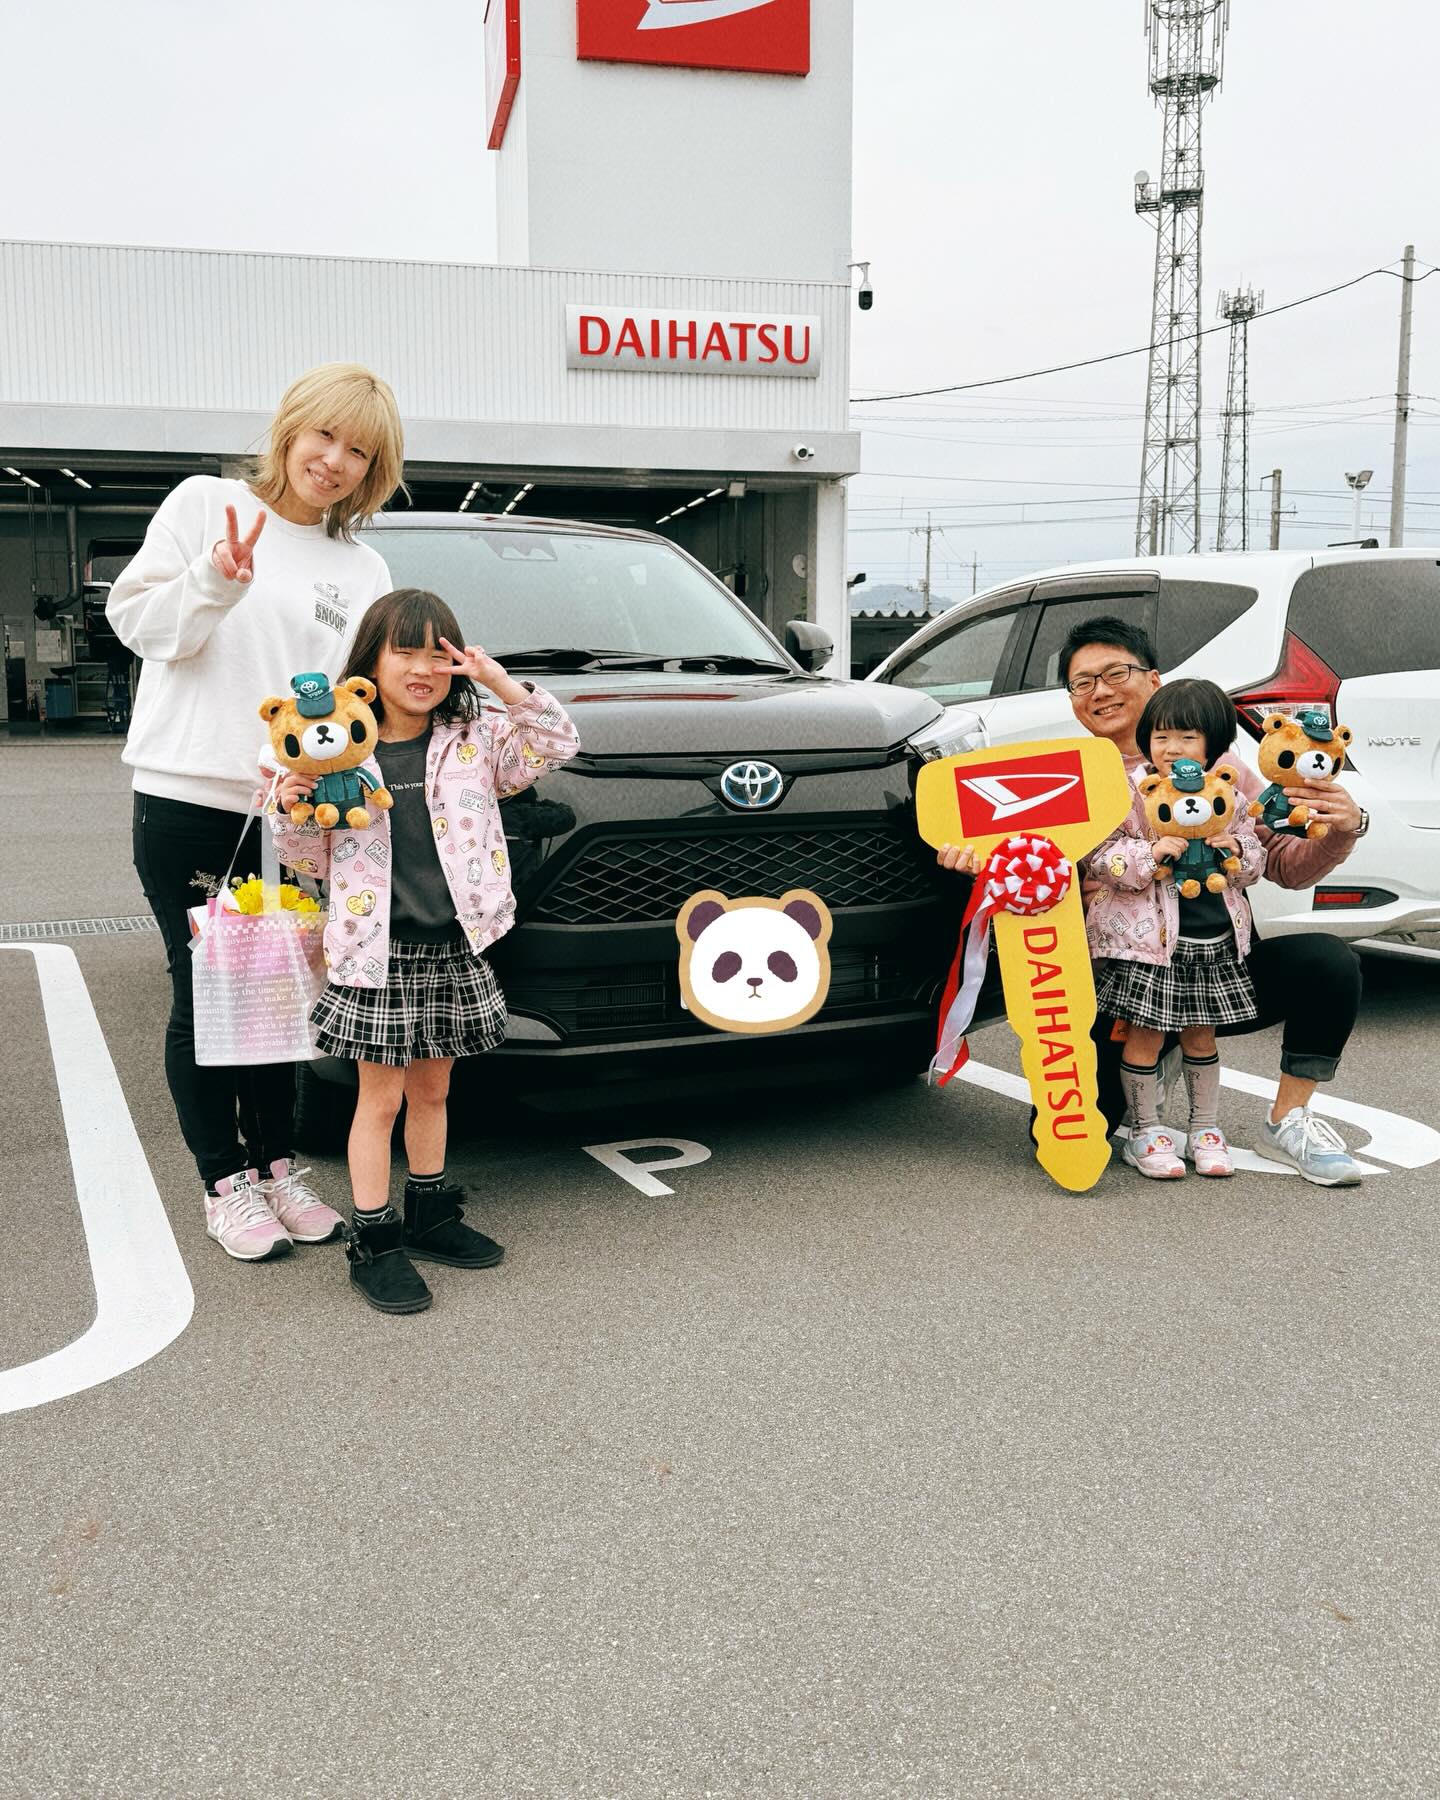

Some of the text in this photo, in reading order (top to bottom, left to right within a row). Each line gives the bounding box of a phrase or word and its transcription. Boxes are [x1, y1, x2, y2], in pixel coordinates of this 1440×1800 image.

[578, 314, 811, 366] DAIHATSU
[1367, 736, 1422, 747] NOTE
[388, 783, 404, 791] This
[264, 993, 287, 1002] make
[1022, 925, 1088, 1141] DAIHATSU
[580, 1137, 712, 1198] P
